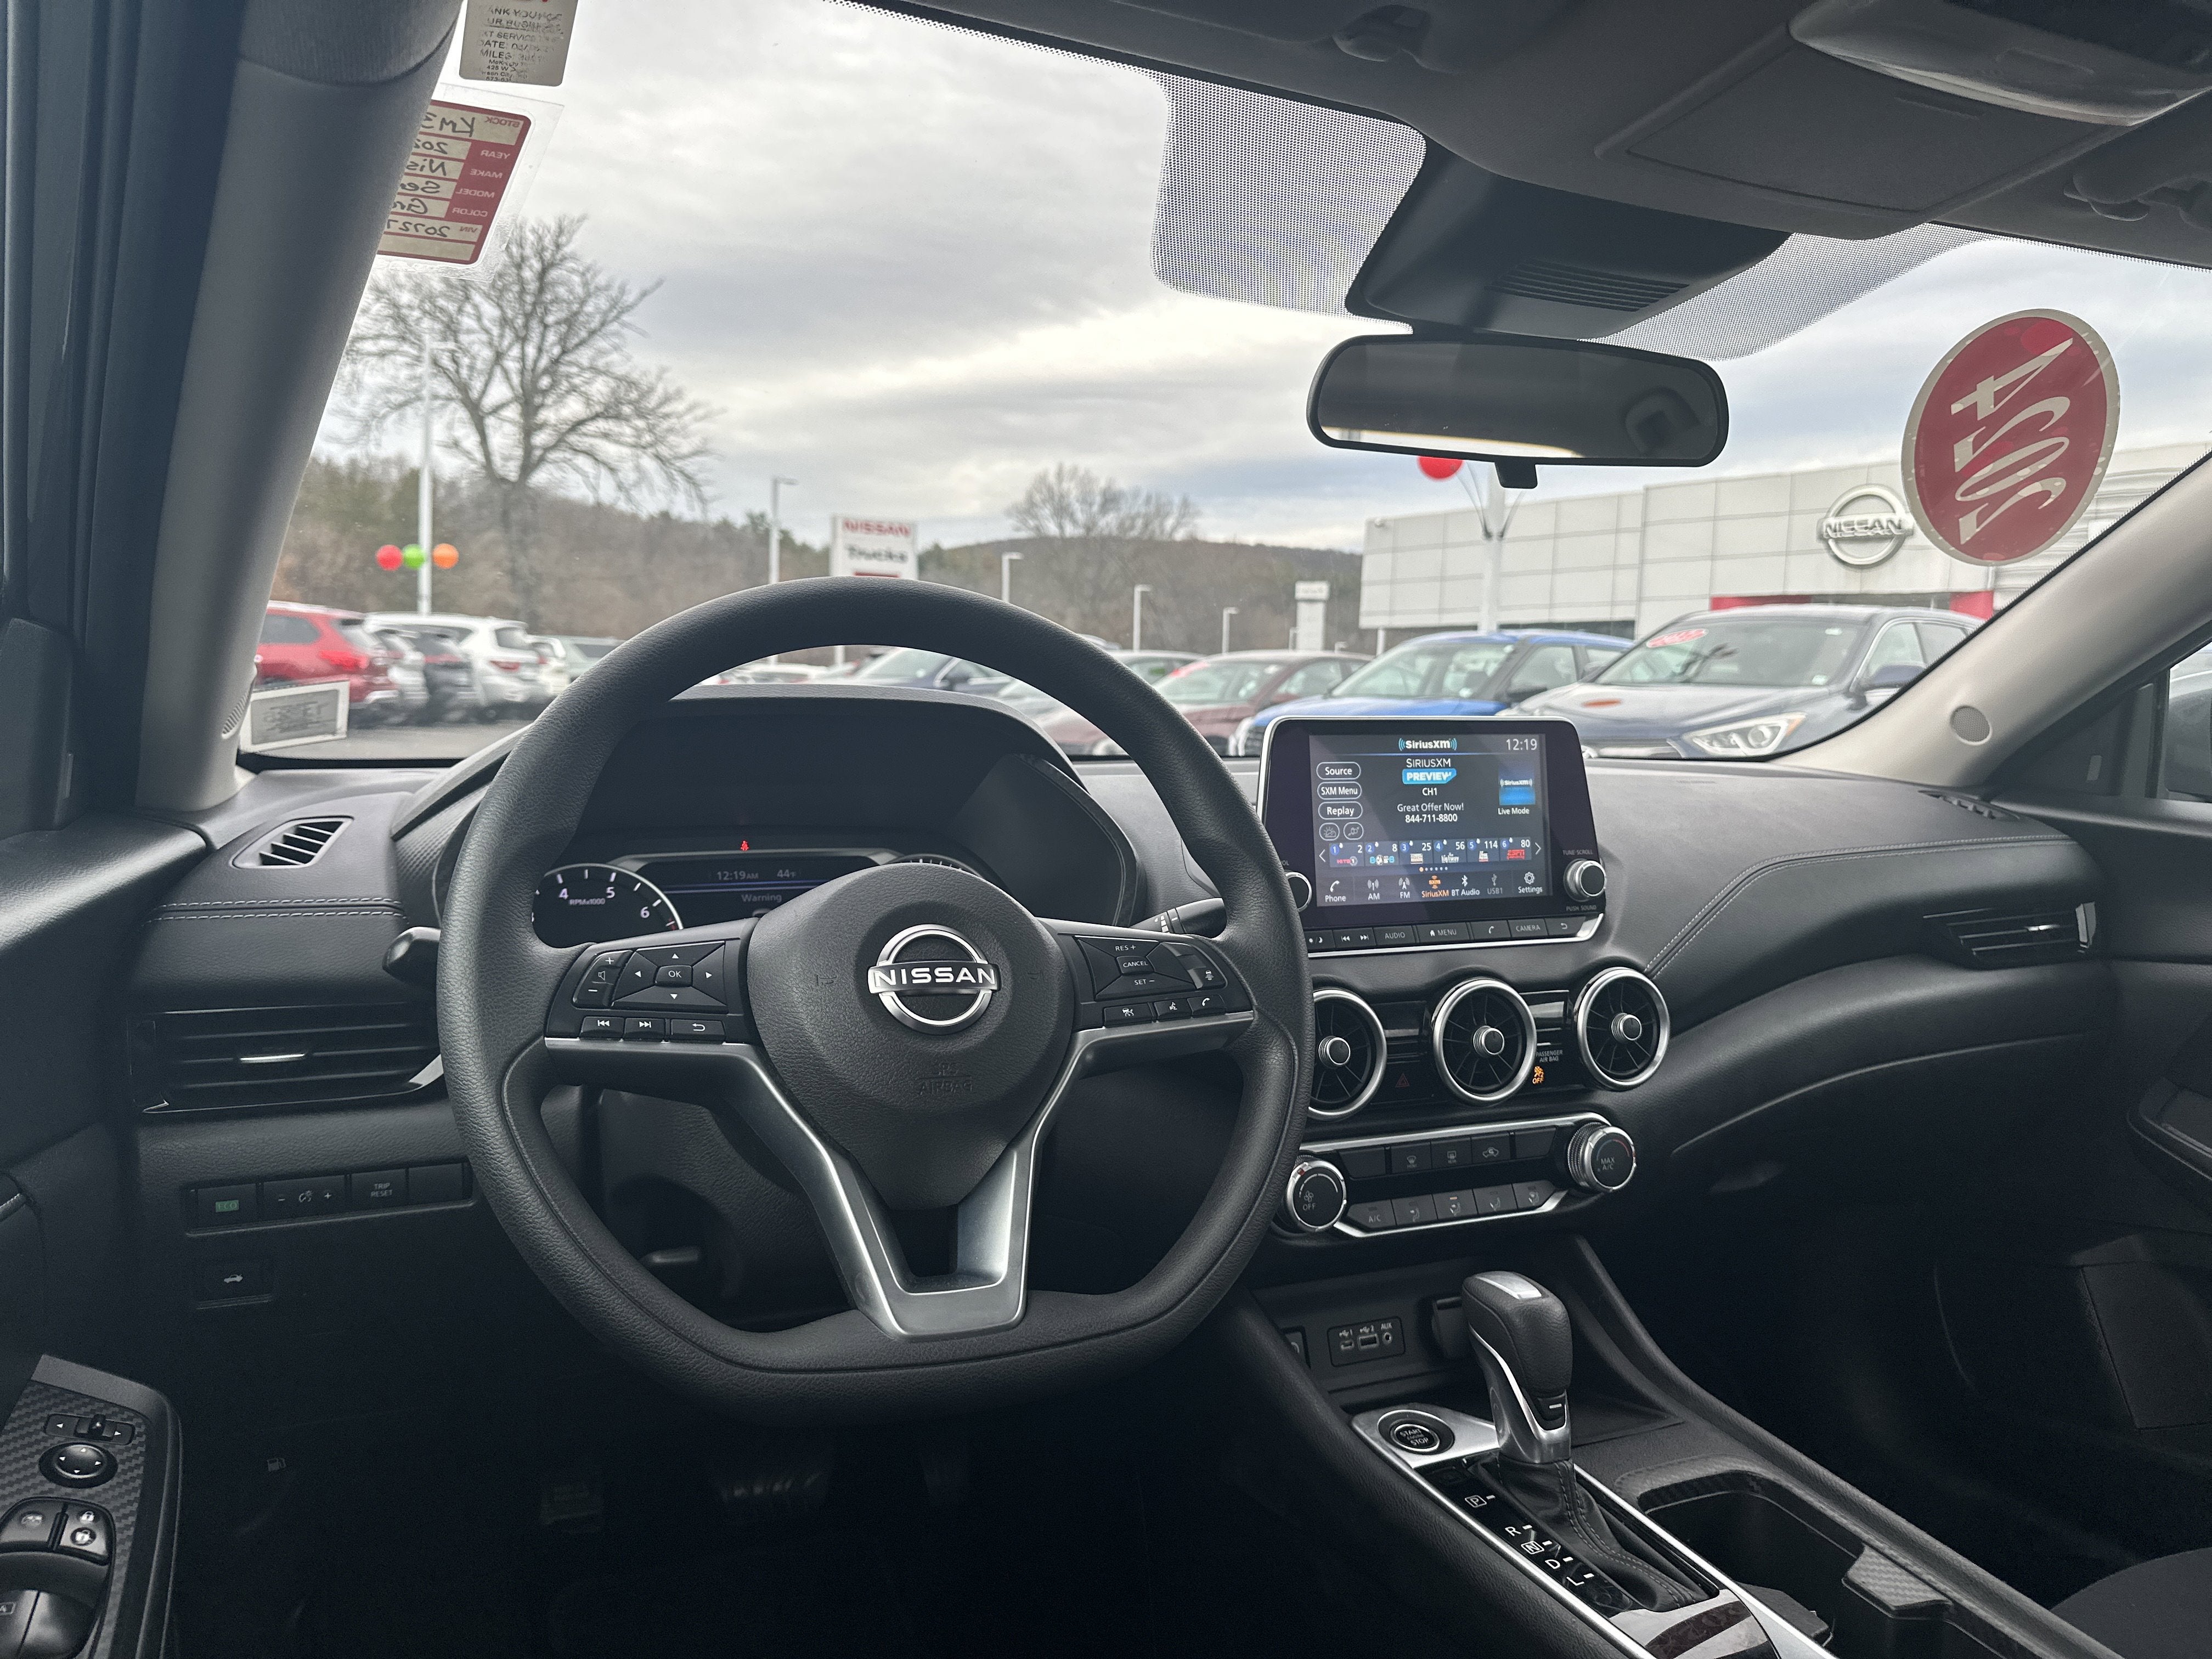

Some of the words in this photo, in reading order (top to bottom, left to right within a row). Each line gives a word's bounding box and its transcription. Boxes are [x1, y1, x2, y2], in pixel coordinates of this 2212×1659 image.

[843, 519, 911, 537] NISSAN
[1823, 518, 1905, 538] NISSAN
[1506, 738, 1537, 751] 12:19
[1406, 758, 1451, 768] SIRIUSXM
[1324, 766, 1352, 775] Source
[1406, 771, 1453, 781] PREVIEW
[1321, 787, 1337, 795] SXM
[1338, 786, 1358, 795] Menu
[1421, 787, 1438, 796] CH1
[1327, 806, 1355, 816] Replay
[1397, 803, 1419, 812] Great
[1421, 802, 1442, 811] Offer
[1443, 802, 1464, 811] Now!
[1405, 813, 1458, 823] 844-711-8800
[1392, 843, 1398, 852] 8
[1421, 842, 1431, 851] 25
[1455, 841, 1465, 850] 56
[1484, 840, 1498, 849] 114
[1520, 839, 1531, 848] 80
[1357, 844, 1363, 853] 2
[558, 888, 569, 900] 4
[606, 886, 616, 899] 5
[1421, 889, 1449, 898] SiriusXM
[1461, 888, 1481, 896] Audio
[1517, 885, 1543, 895] Settings
[741, 894, 782, 903] Warning
[1325, 894, 1346, 902] Phone
[640, 906, 650, 918] 6
[1515, 924, 1541, 932] CAMERA
[668, 970, 682, 978] OK
[874, 967, 996, 987] NISSAN
[1536, 1049, 1563, 1058] PASSENGER
[370, 1189, 393, 1198] RESET
[1302, 1203, 1316, 1211] OFF
[1368, 1215, 1382, 1223] A/C
[1400, 1428, 1422, 1437] START
[1410, 1437, 1429, 1446] STOP
[1470, 1497, 1480, 1506] P
[1505, 1526, 1521, 1536] R
[1525, 1543, 1540, 1553] N
[1544, 1559, 1561, 1570] D
[1566, 1576, 1584, 1586] L
